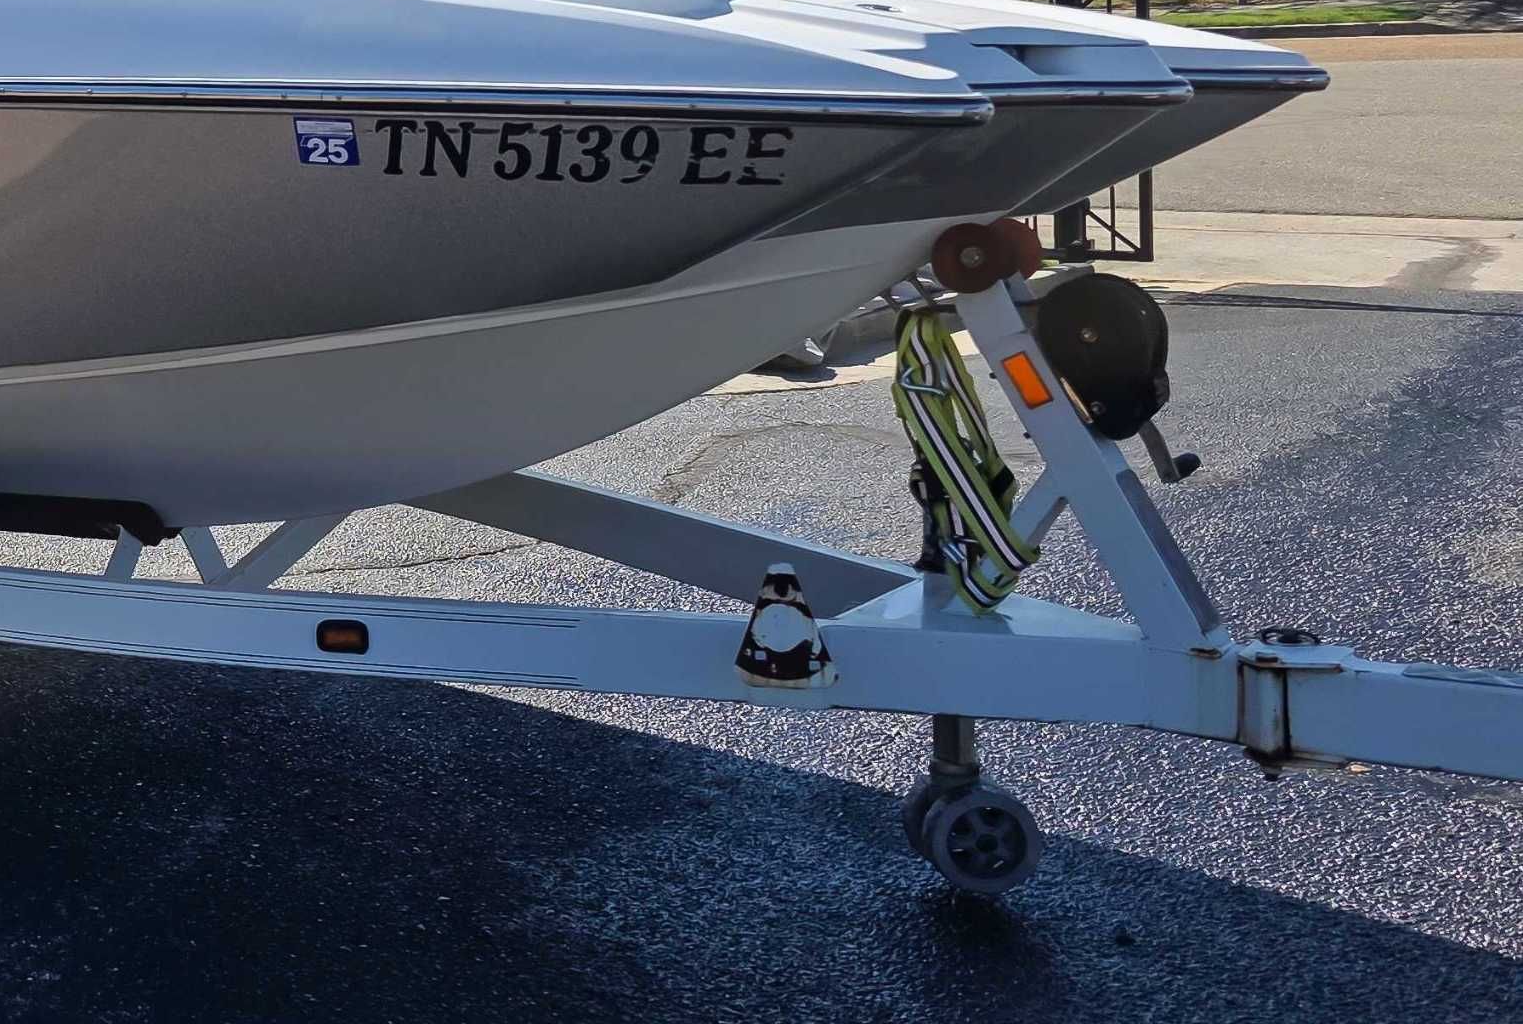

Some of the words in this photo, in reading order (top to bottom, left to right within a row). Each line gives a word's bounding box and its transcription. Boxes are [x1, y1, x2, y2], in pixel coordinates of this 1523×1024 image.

[307, 137, 349, 164] 25
[374, 118, 475, 177] TN
[493, 122, 660, 184] 5139
[679, 126, 796, 187] EE
